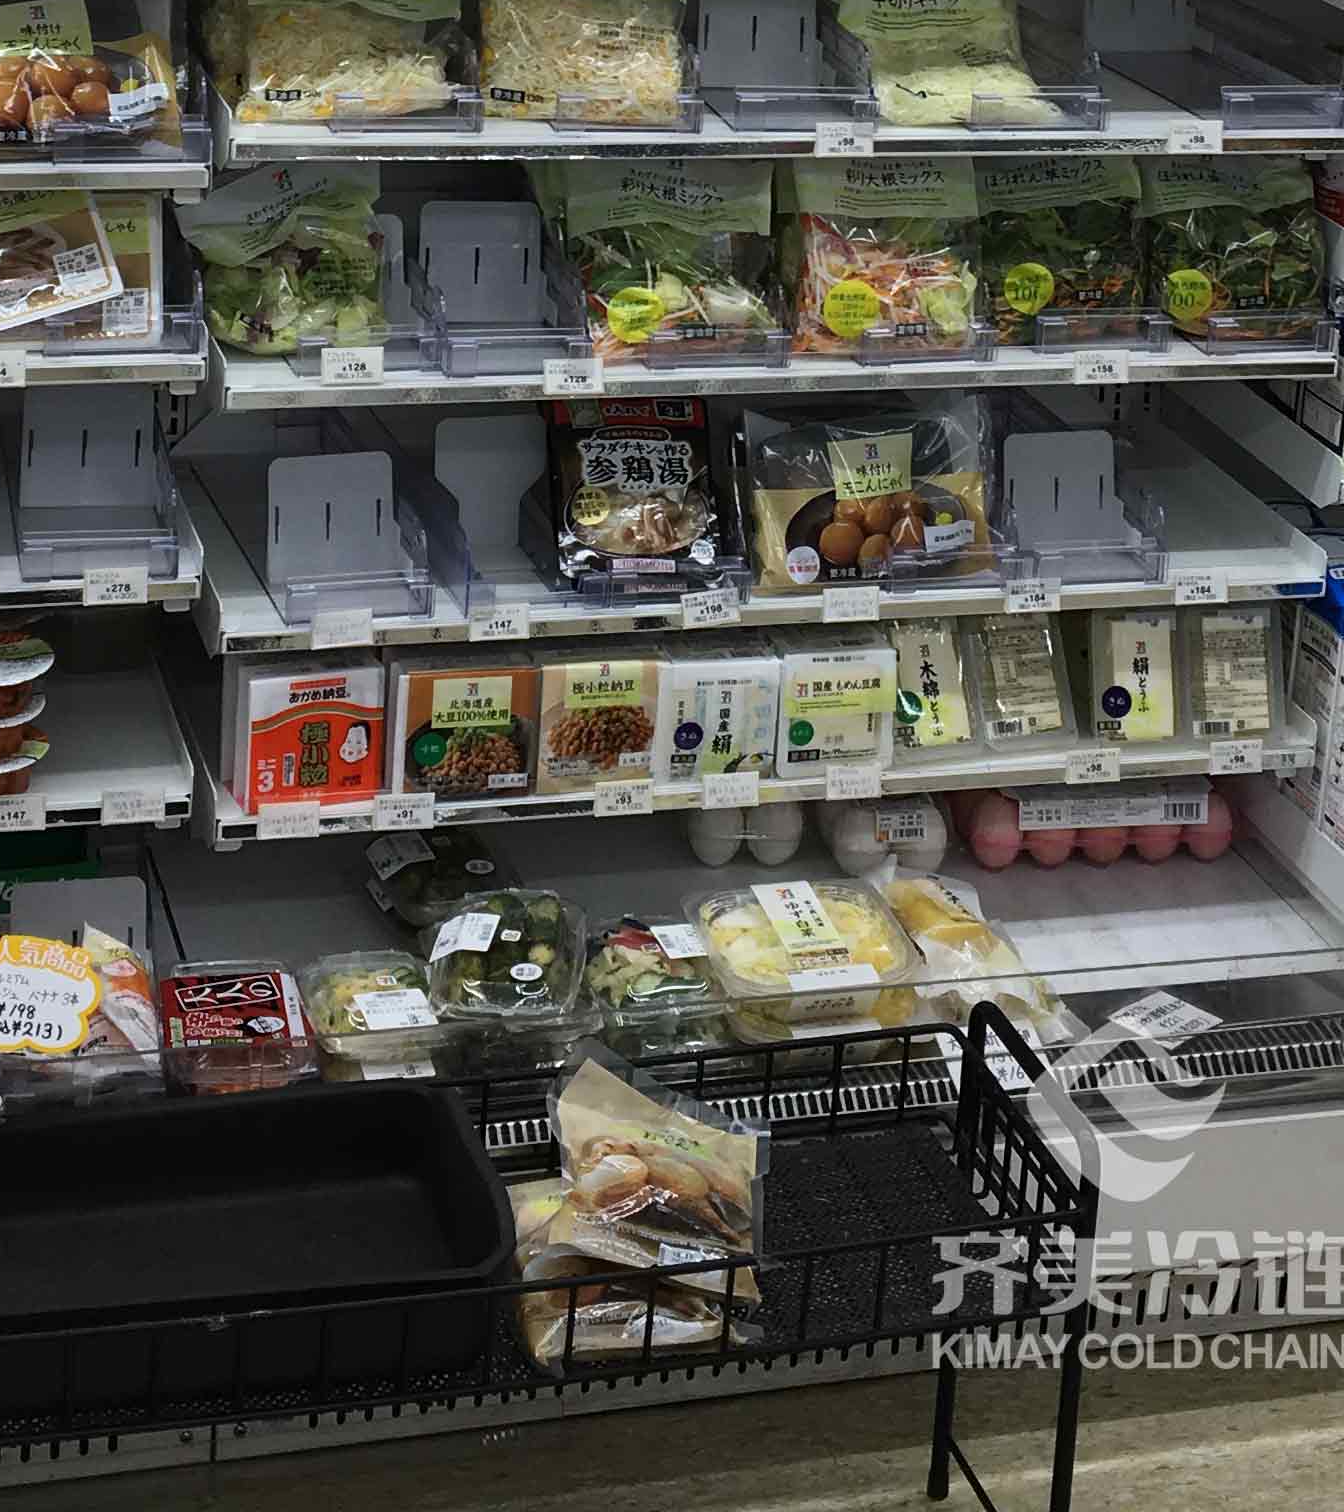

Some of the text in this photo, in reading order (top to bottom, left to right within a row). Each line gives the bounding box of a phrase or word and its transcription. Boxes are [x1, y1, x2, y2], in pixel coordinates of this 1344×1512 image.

[586, 455, 689, 485] 参鶏湯
[857, 464, 892, 477] 味付け
[106, 583, 130, 593] ¥278
[488, 620, 512, 630] ¥147
[572, 678, 636, 694] 極小粒納豆
[289, 686, 347, 705] おかめ納豆
[450, 698, 493, 709] 北海道産
[433, 708, 509, 722] 大豆100%使用
[712, 733, 732, 755] 絹
[2, 811, 26, 821] ¥147
[396, 810, 413, 820] ¥91
